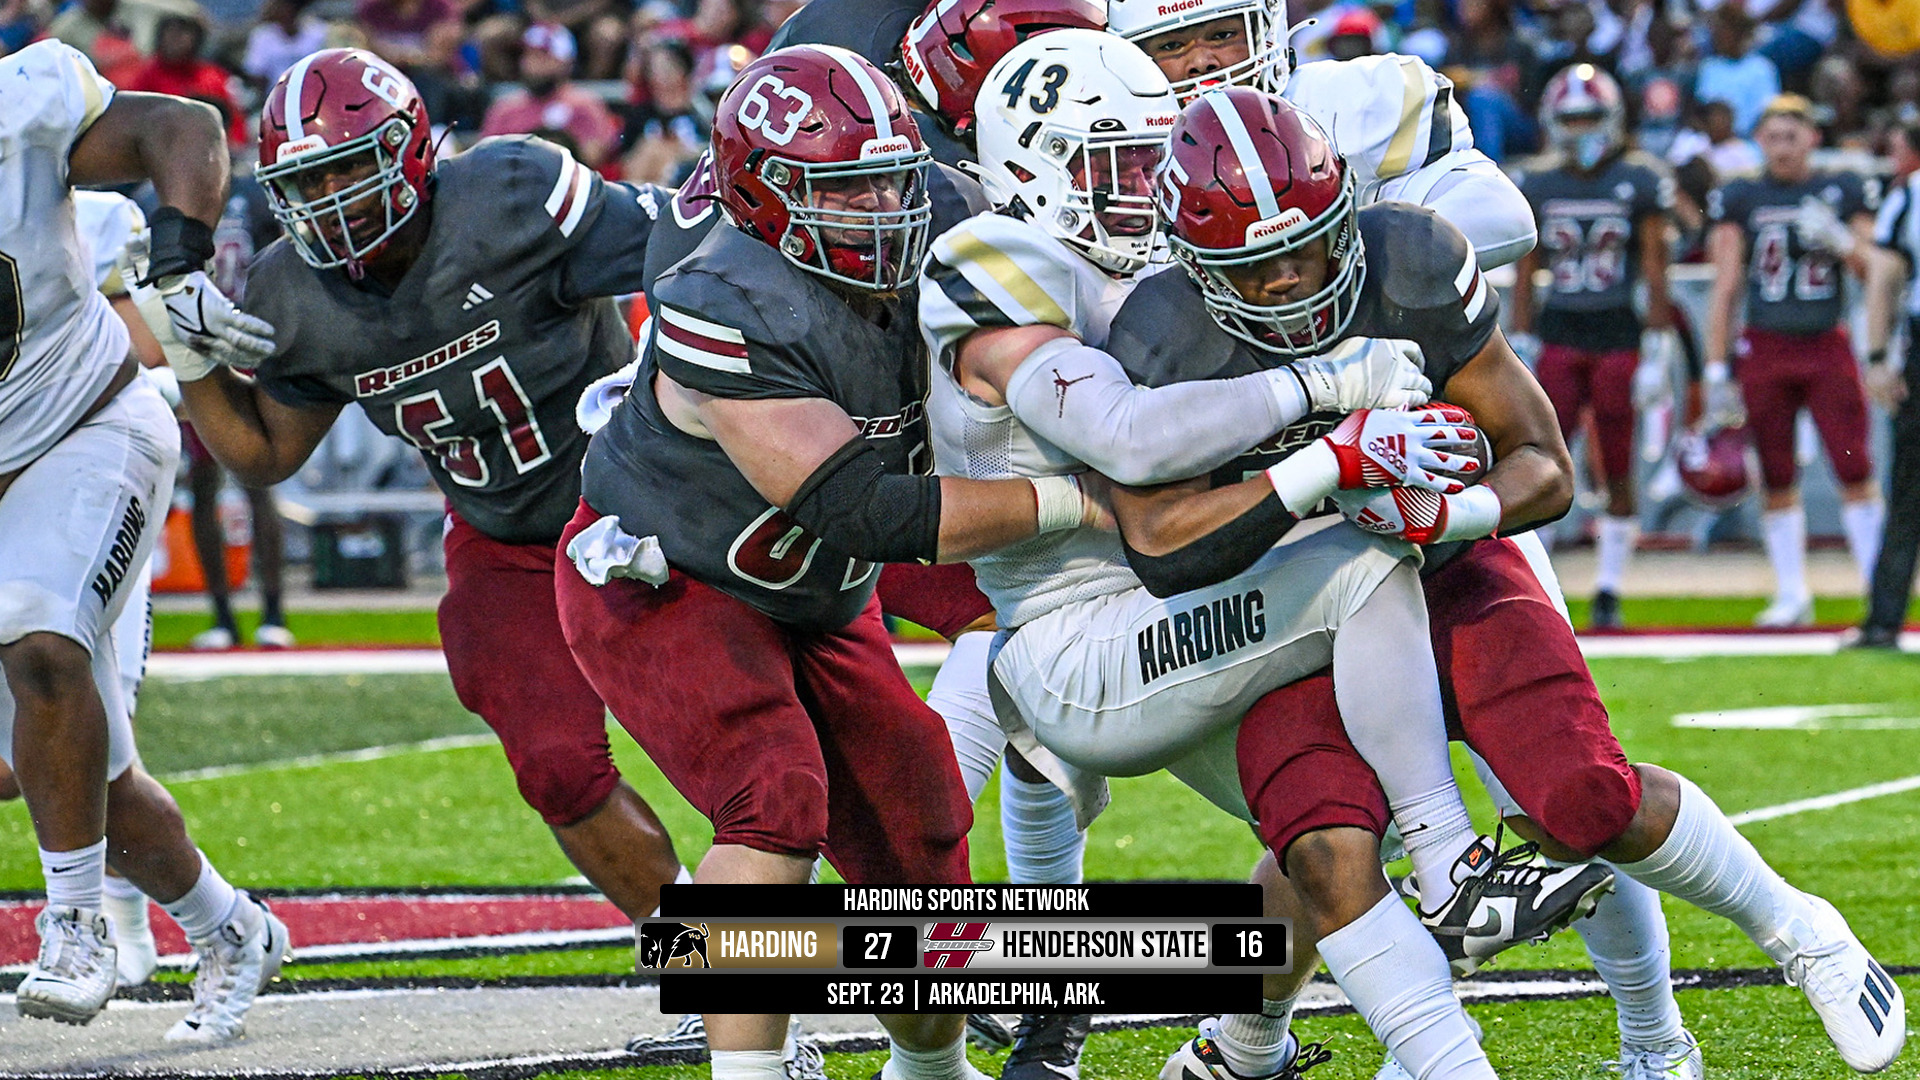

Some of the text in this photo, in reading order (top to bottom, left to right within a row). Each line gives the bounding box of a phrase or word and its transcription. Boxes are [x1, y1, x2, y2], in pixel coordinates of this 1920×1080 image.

[737, 74, 814, 147] 63
[1001, 58, 1070, 115] 43
[1253, 214, 1301, 239] Riddell
[354, 319, 501, 398] REDDIES
[1368, 441, 1409, 474] adidas
[91, 495, 146, 610] HARDING
[1138, 588, 1267, 686] HARDING
